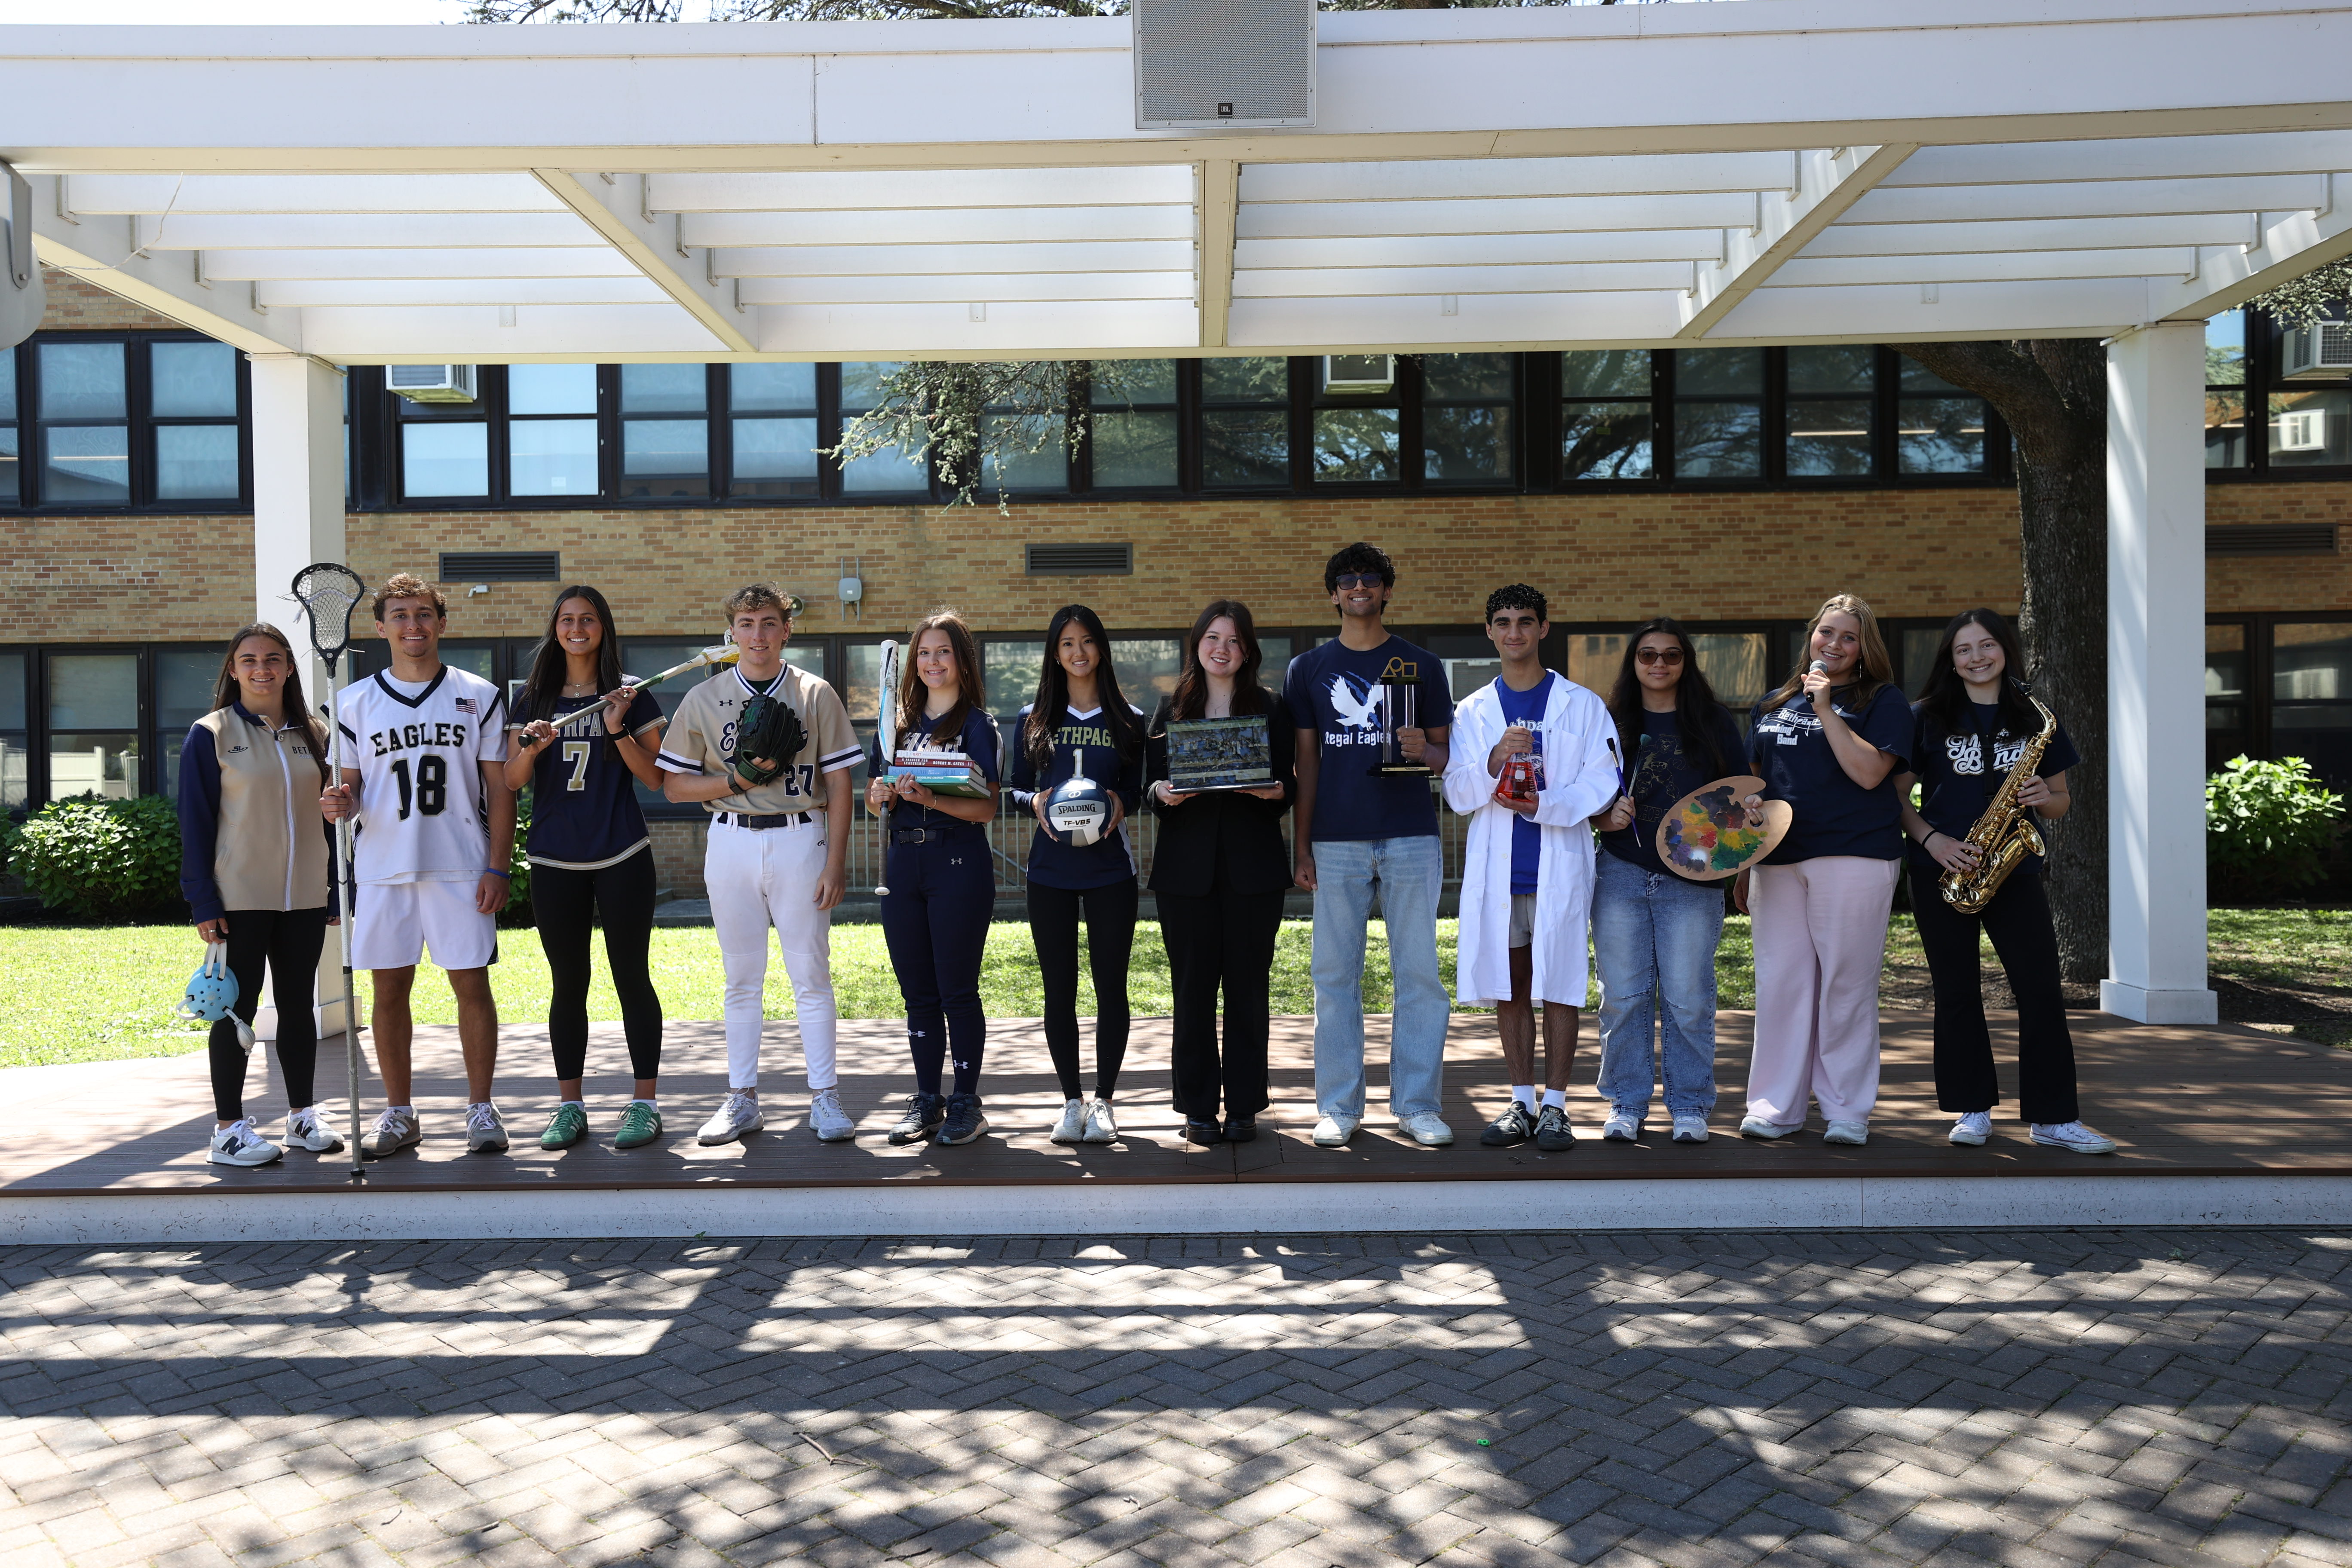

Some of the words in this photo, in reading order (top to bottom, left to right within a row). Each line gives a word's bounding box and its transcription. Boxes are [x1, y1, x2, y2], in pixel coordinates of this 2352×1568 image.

[553, 712, 603, 737] THPA
[1053, 727, 1115, 748] ETHPAG
[1357, 730, 1384, 746] Eagle
[370, 723, 466, 757] EAGLES
[1776, 734, 1798, 746] Band
[563, 741, 590, 791] 7
[1072, 748, 1084, 778] 1
[1953, 740, 2026, 775] Bnd
[390, 753, 447, 822] 18
[784, 763, 815, 797] 27
[1058, 803, 1096, 815] SPALDING
